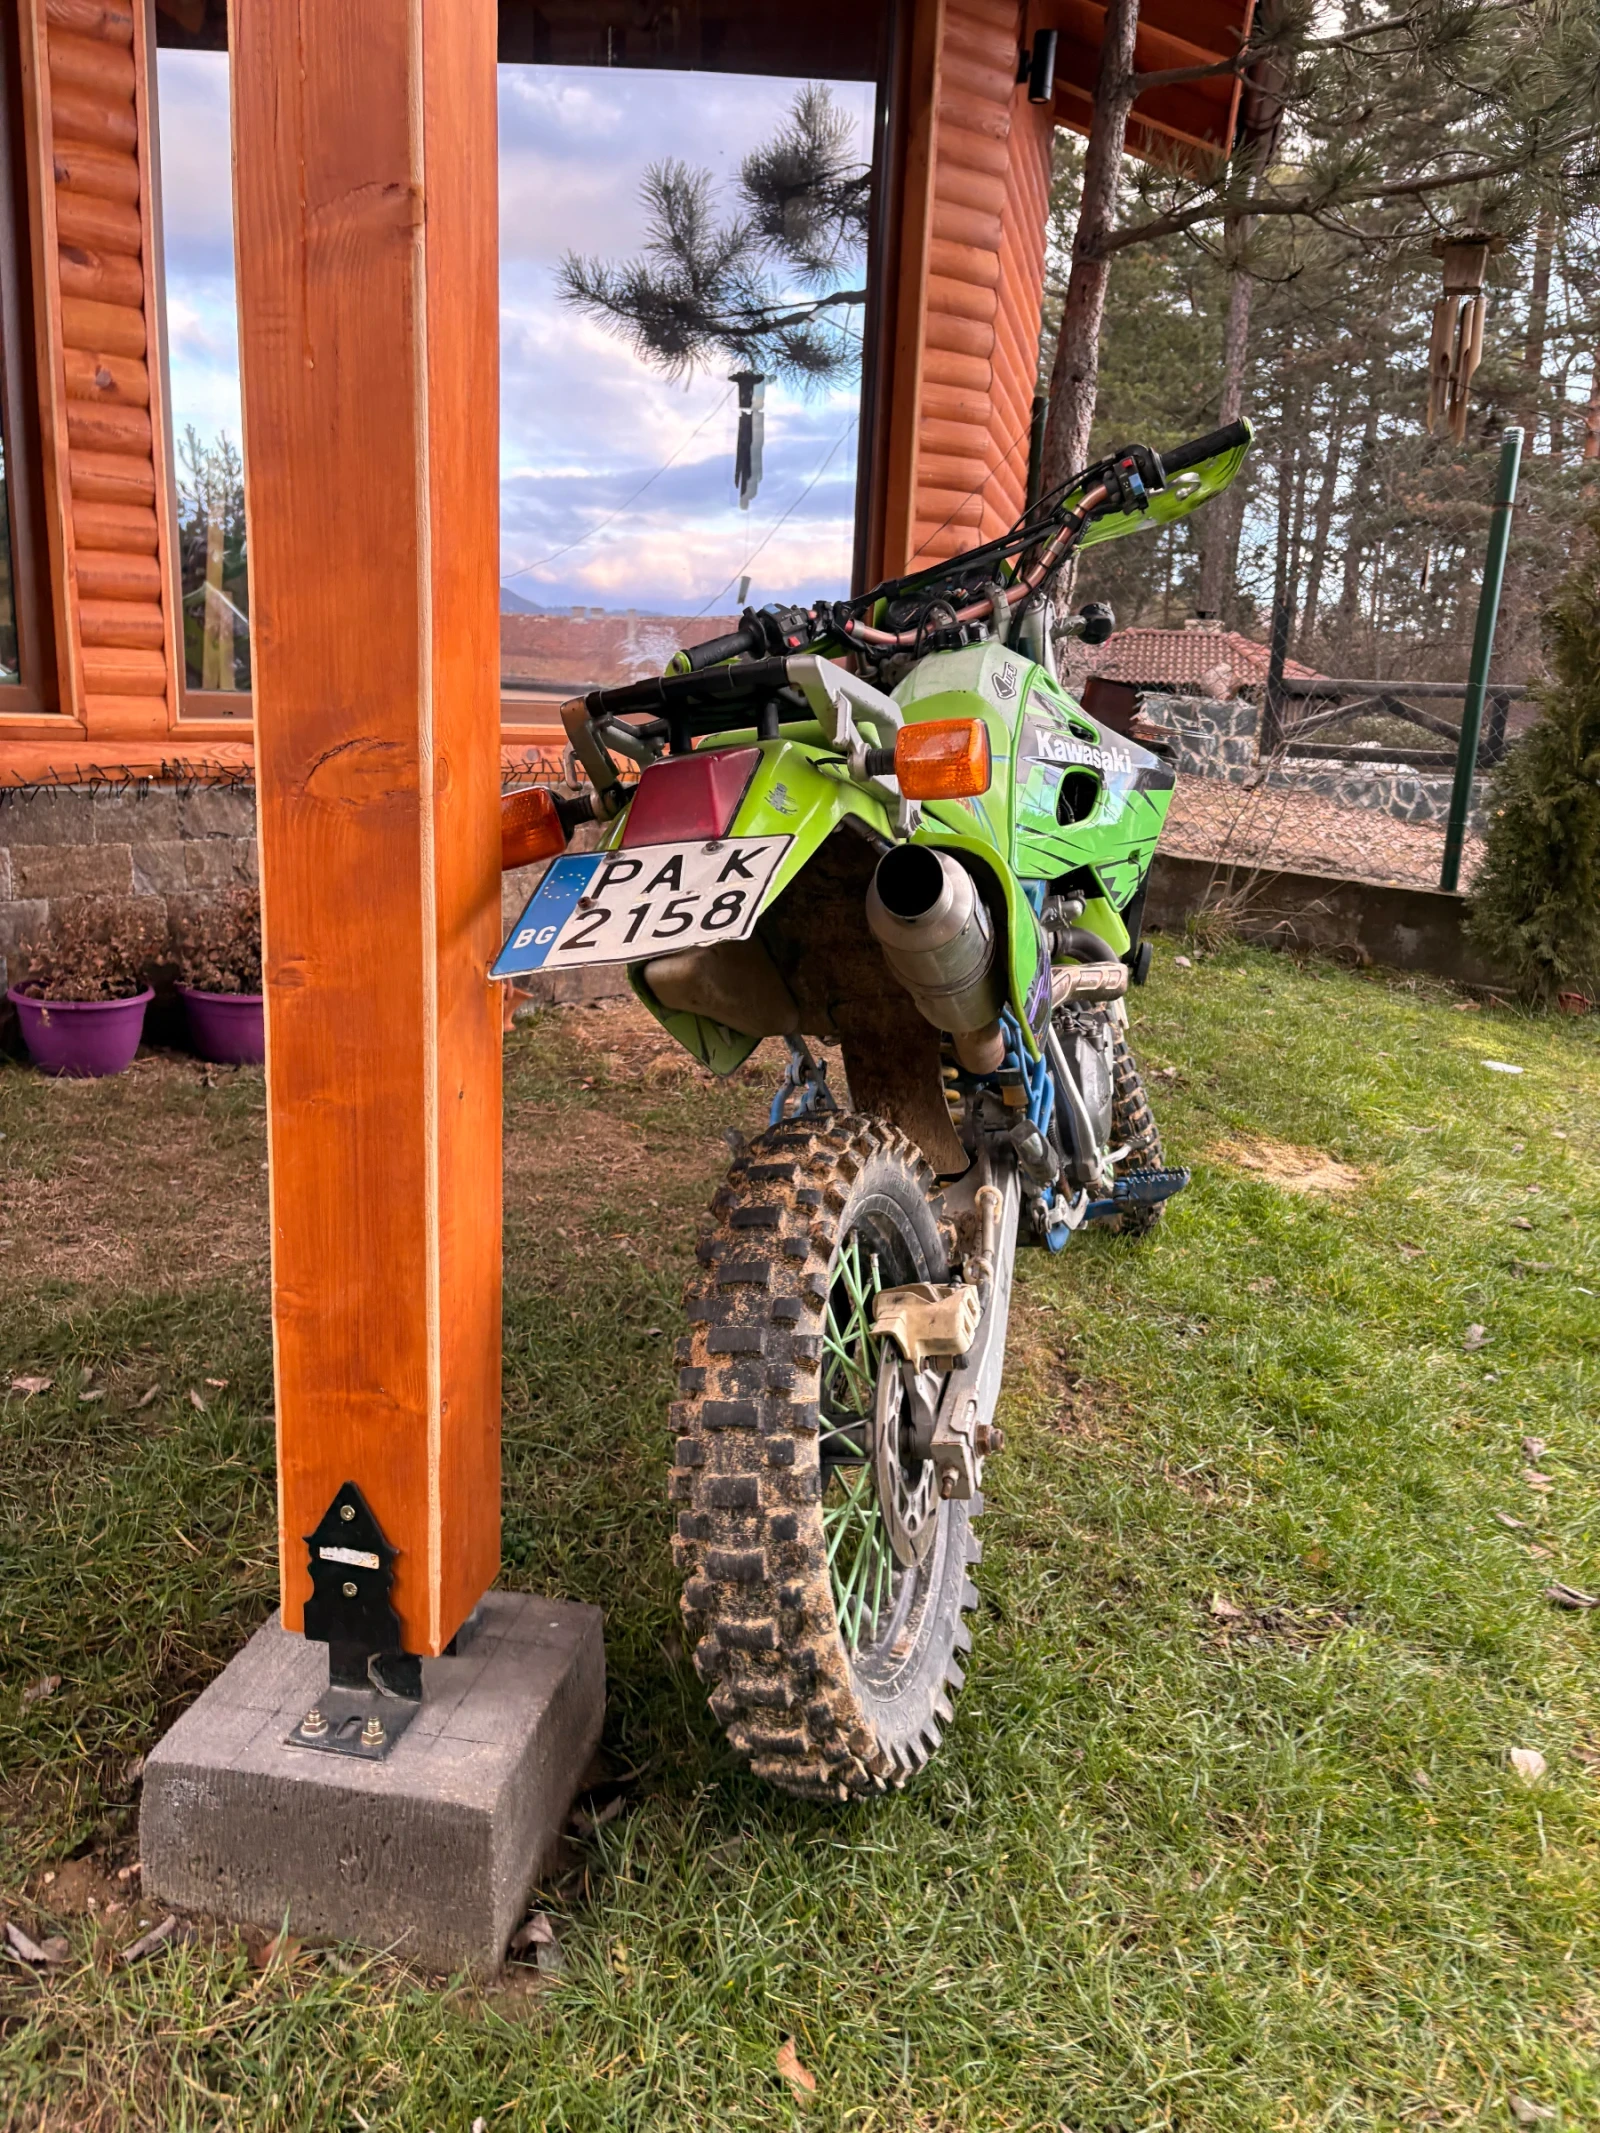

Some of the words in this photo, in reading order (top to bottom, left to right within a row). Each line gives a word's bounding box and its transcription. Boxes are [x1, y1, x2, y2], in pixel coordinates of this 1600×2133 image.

[1035, 729, 1132, 774] Kawasaki
[591, 854, 684, 900] PA
[716, 845, 772, 883] K
[512, 925, 558, 949] BG
[559, 890, 747, 951] 2158
